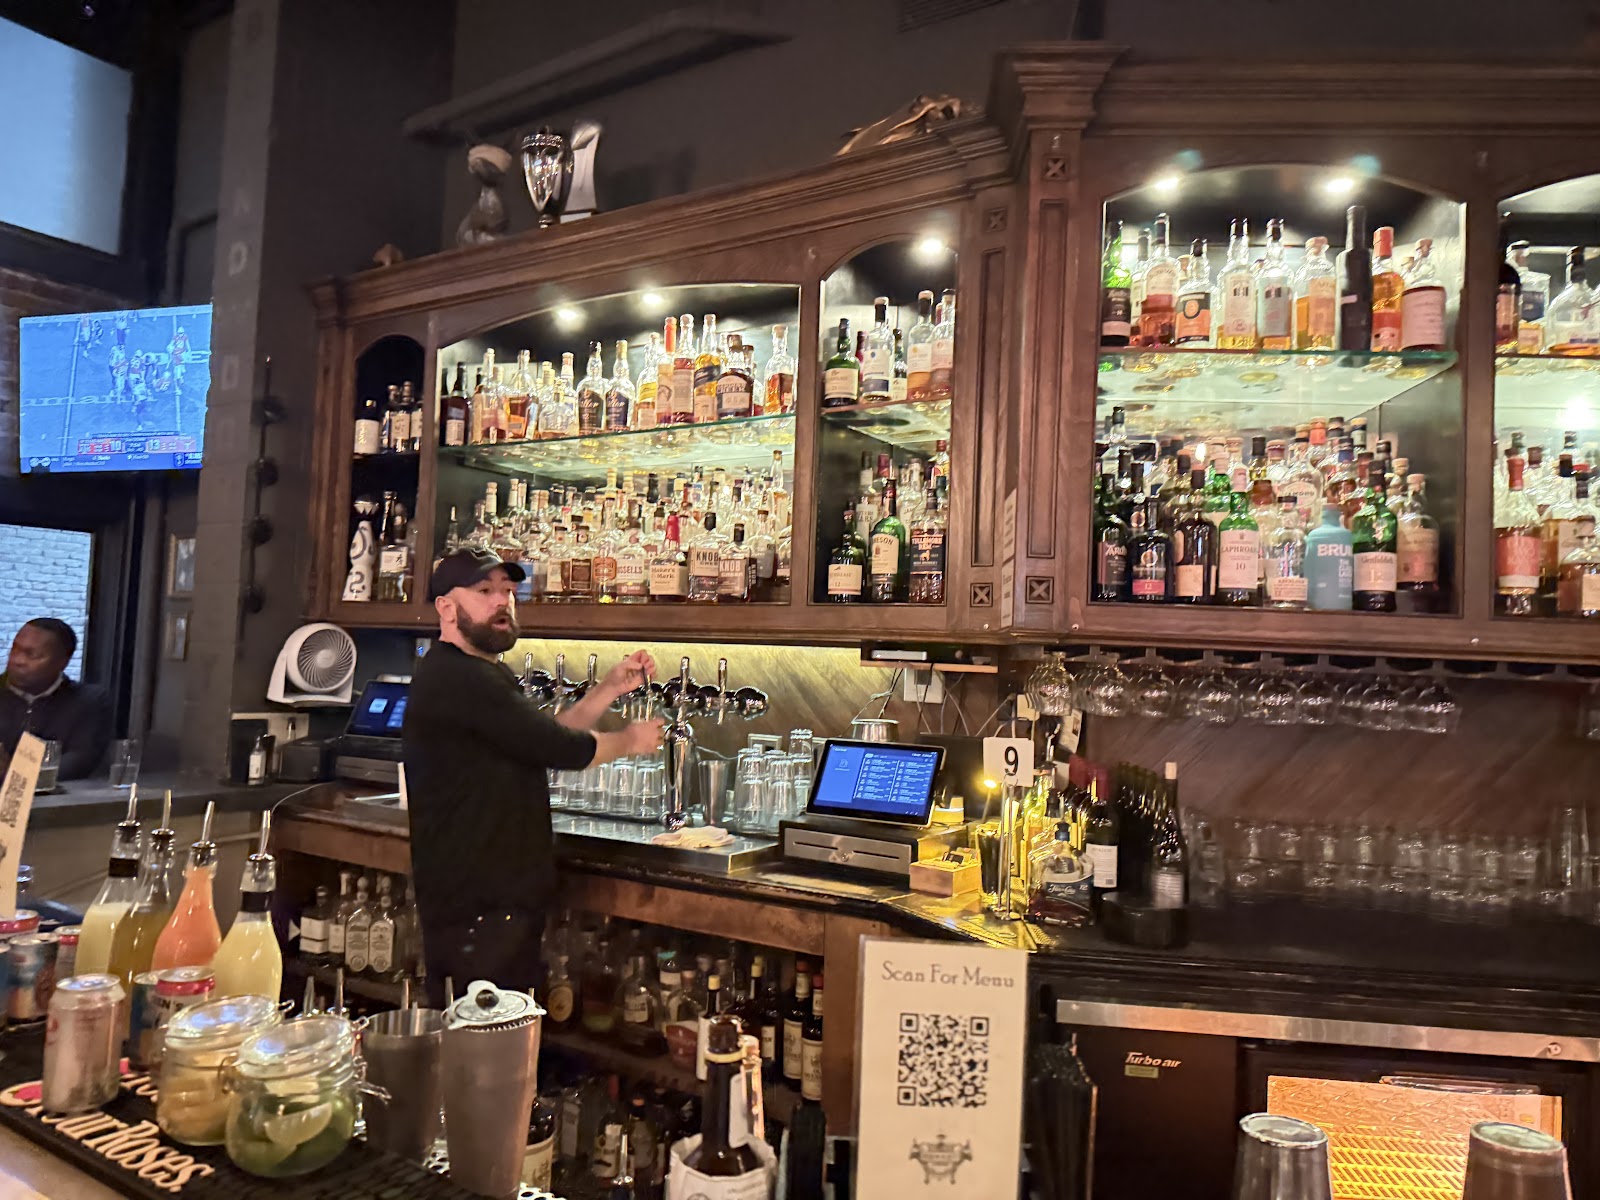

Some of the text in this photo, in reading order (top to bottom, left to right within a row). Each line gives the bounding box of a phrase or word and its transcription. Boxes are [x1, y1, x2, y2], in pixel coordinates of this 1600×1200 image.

[1220, 545, 1258, 553] LAPHROA
[696, 551, 718, 562] KNOB
[719, 560, 741, 572] KNOB
[1004, 746, 1019, 776] 9
[881, 960, 1014, 988] Scan For Menu
[1125, 1051, 1182, 1068] Turbo air
